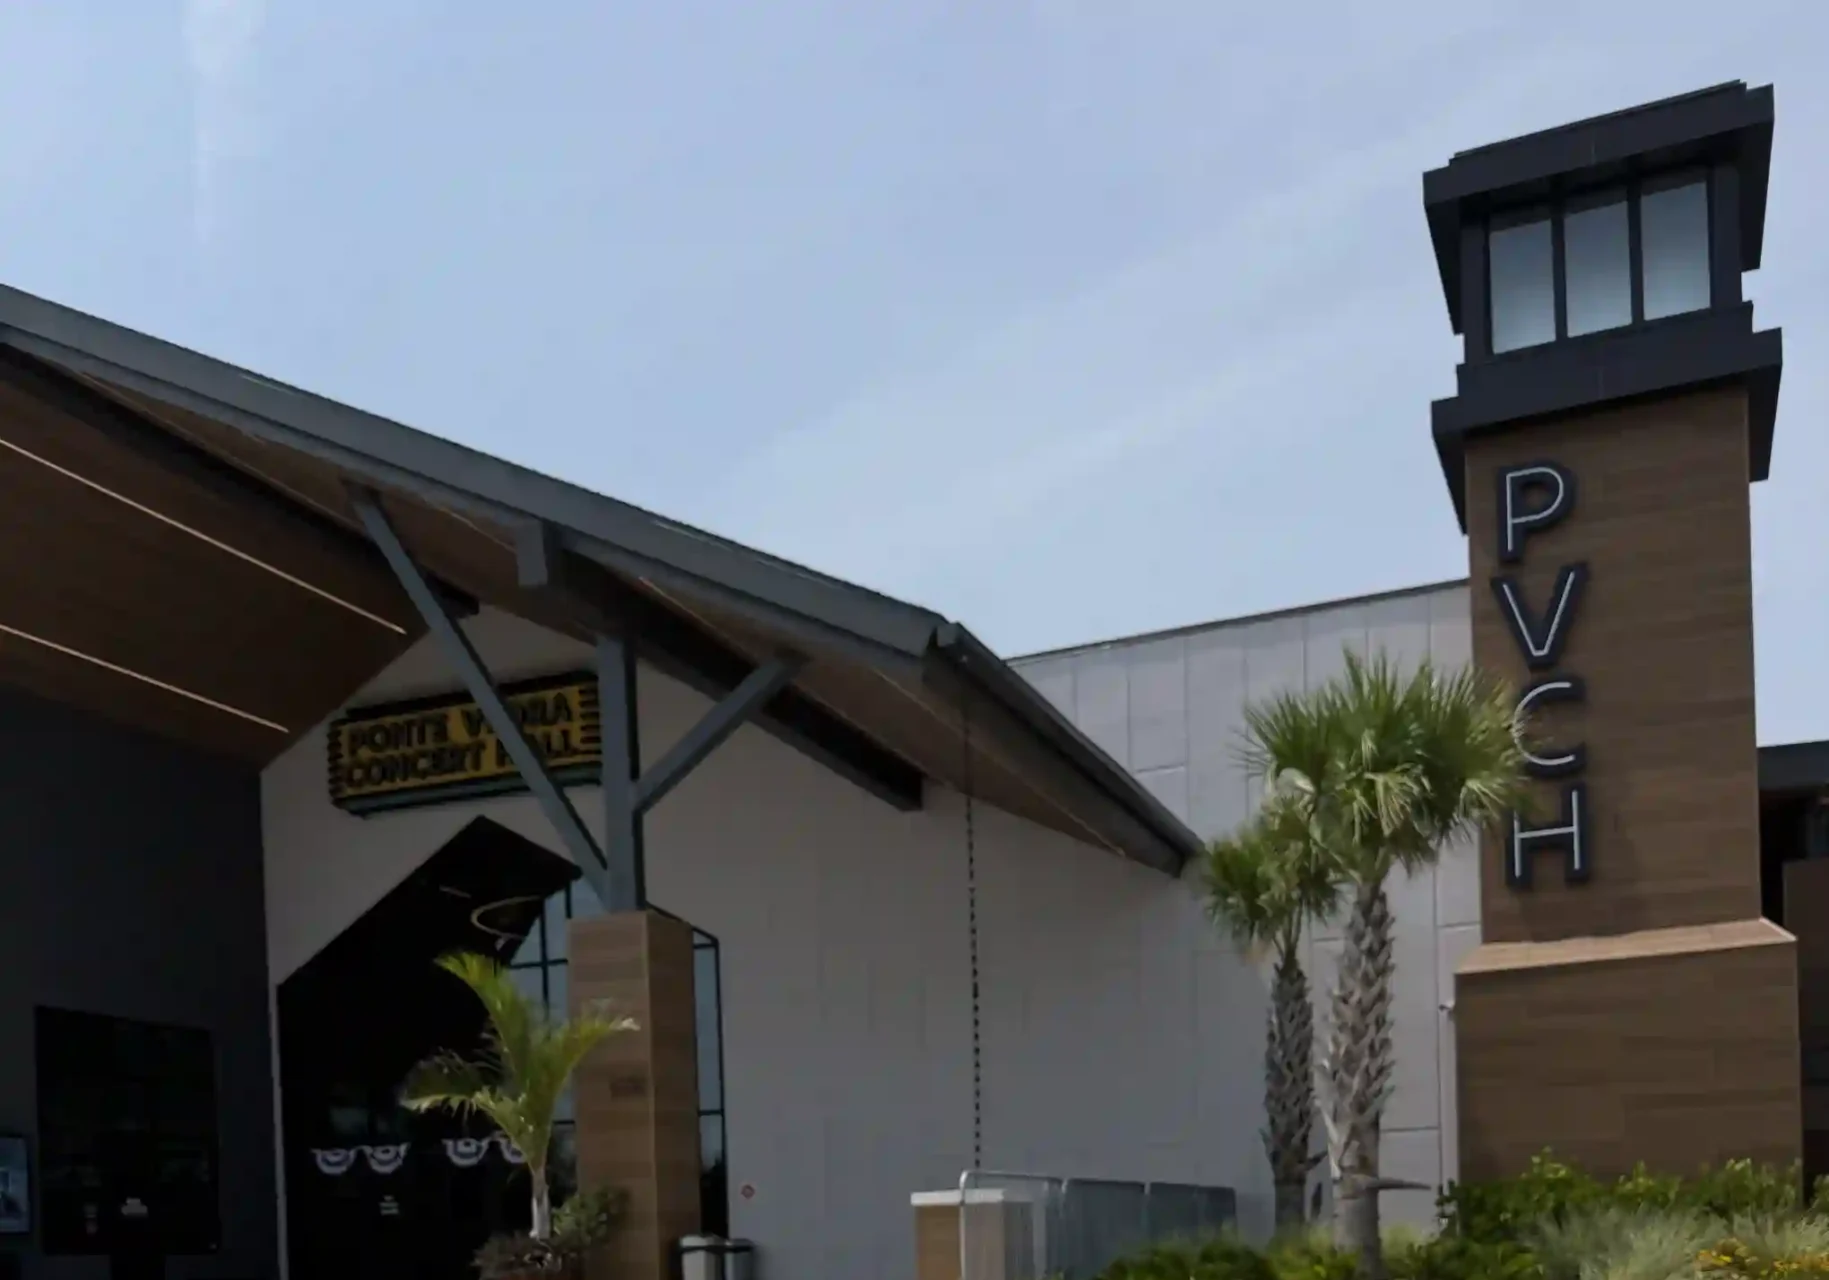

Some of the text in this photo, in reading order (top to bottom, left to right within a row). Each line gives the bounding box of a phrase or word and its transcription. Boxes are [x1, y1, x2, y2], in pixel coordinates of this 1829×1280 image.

[1491, 457, 1590, 889] PVCH
[348, 692, 572, 756] PONTE VRA
[346, 740, 485, 787] CONCERT
